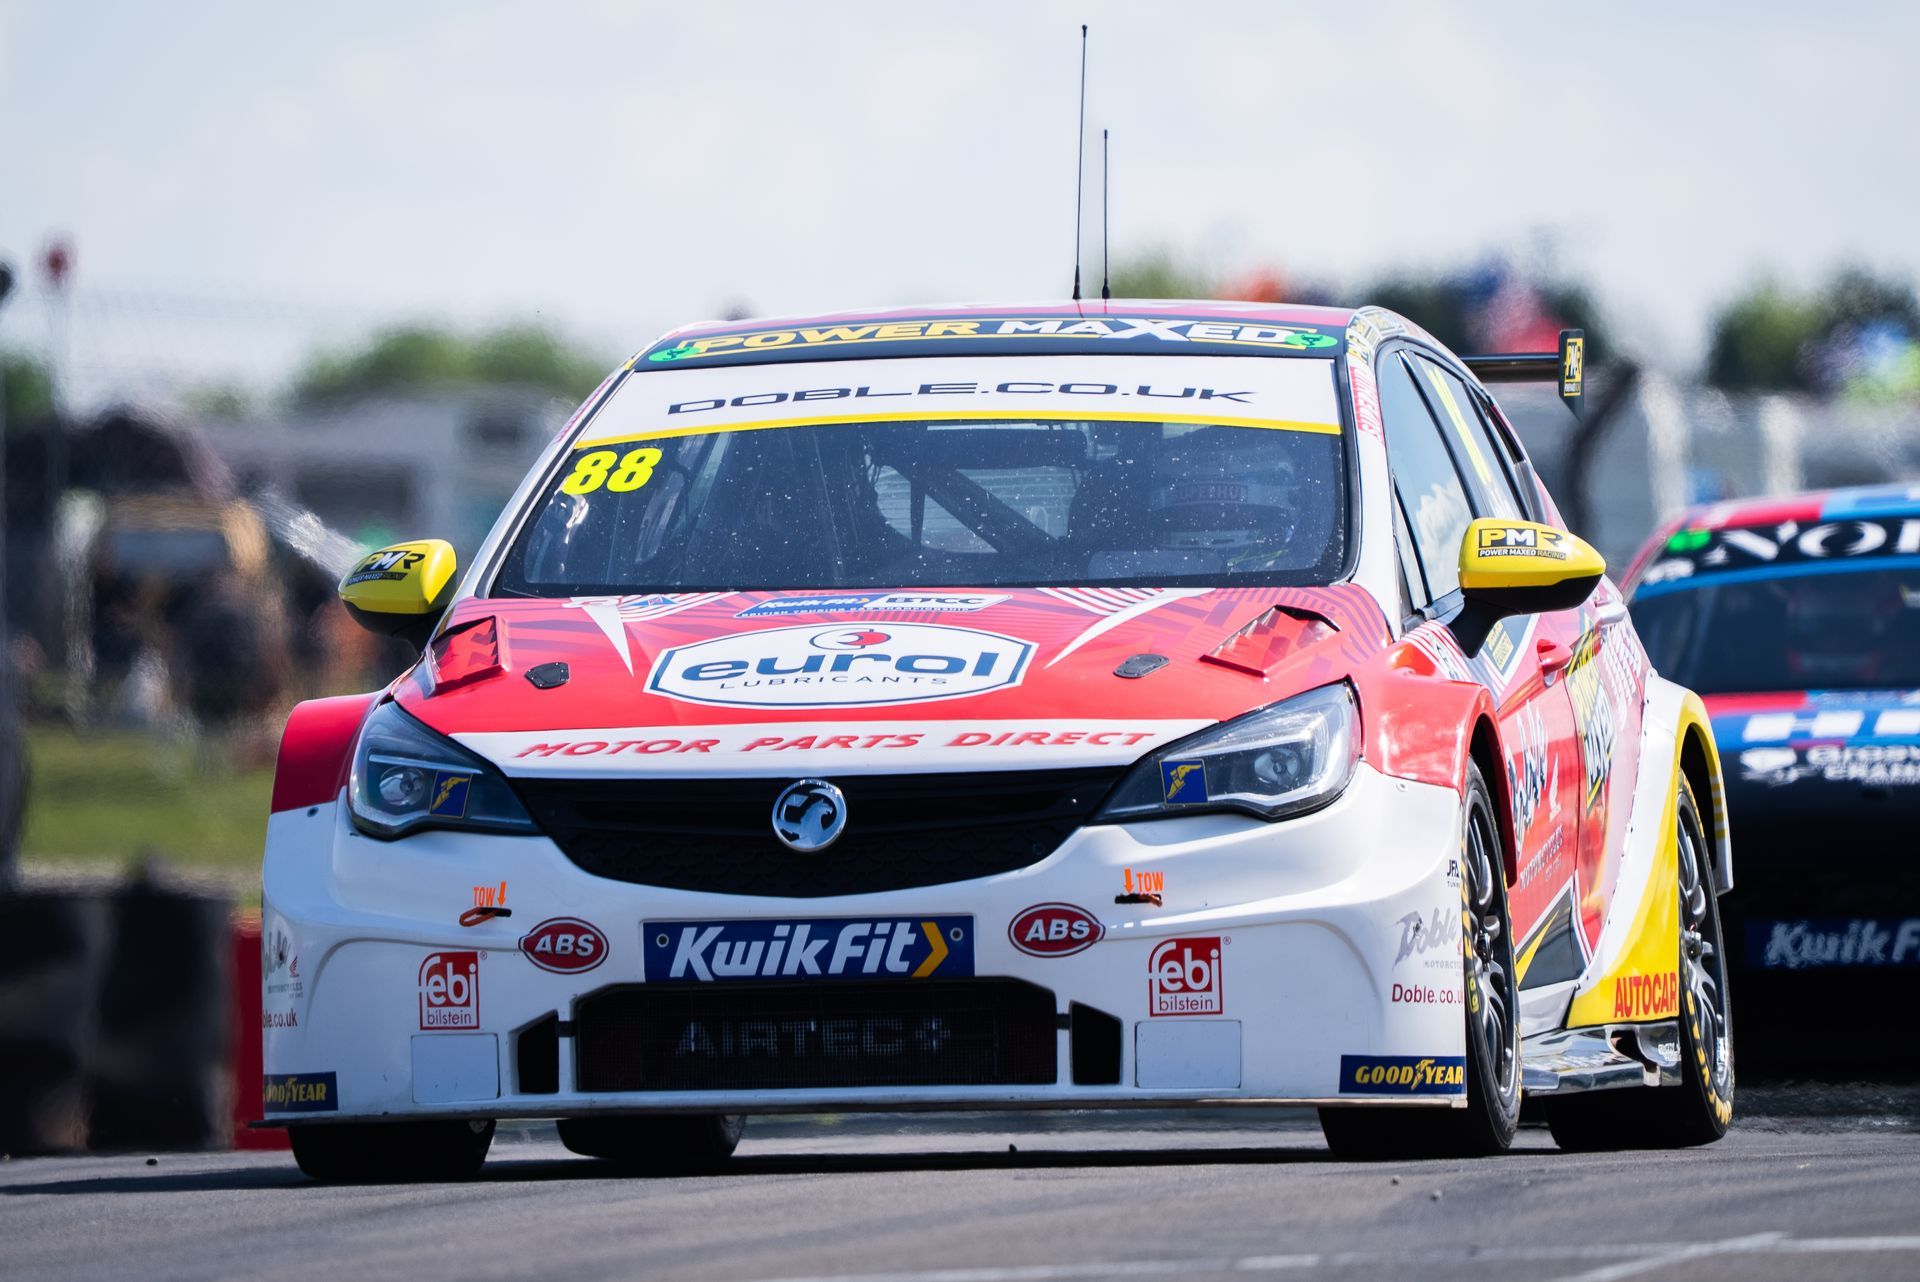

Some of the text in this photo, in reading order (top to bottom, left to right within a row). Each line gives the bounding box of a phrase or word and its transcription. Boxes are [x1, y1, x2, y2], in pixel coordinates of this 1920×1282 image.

[698, 319, 1293, 353] POWER MAXED
[667, 382, 1259, 415] DOBLE.CO.UK
[561, 448, 662, 496] 88
[1480, 528, 1564, 548] PMR
[1480, 548, 1566, 560] POWER MAXED RACING
[681, 650, 1000, 681] eurol
[719, 675, 949, 691] LUBRICANTS
[515, 732, 1155, 758] MOTOR PARTS DIRECT
[1136, 872, 1164, 892] TOW
[473, 887, 497, 907] TOW
[1024, 917, 1090, 942] ABS
[534, 933, 596, 957] ABS
[1158, 995, 1214, 1013] bilstein
[1392, 984, 1464, 1007] Doble.co.u
[1614, 972, 1677, 1018] AUTOCAR
[426, 1009, 473, 1027] bilstein
[675, 1019, 907, 1056] AIRTEC
